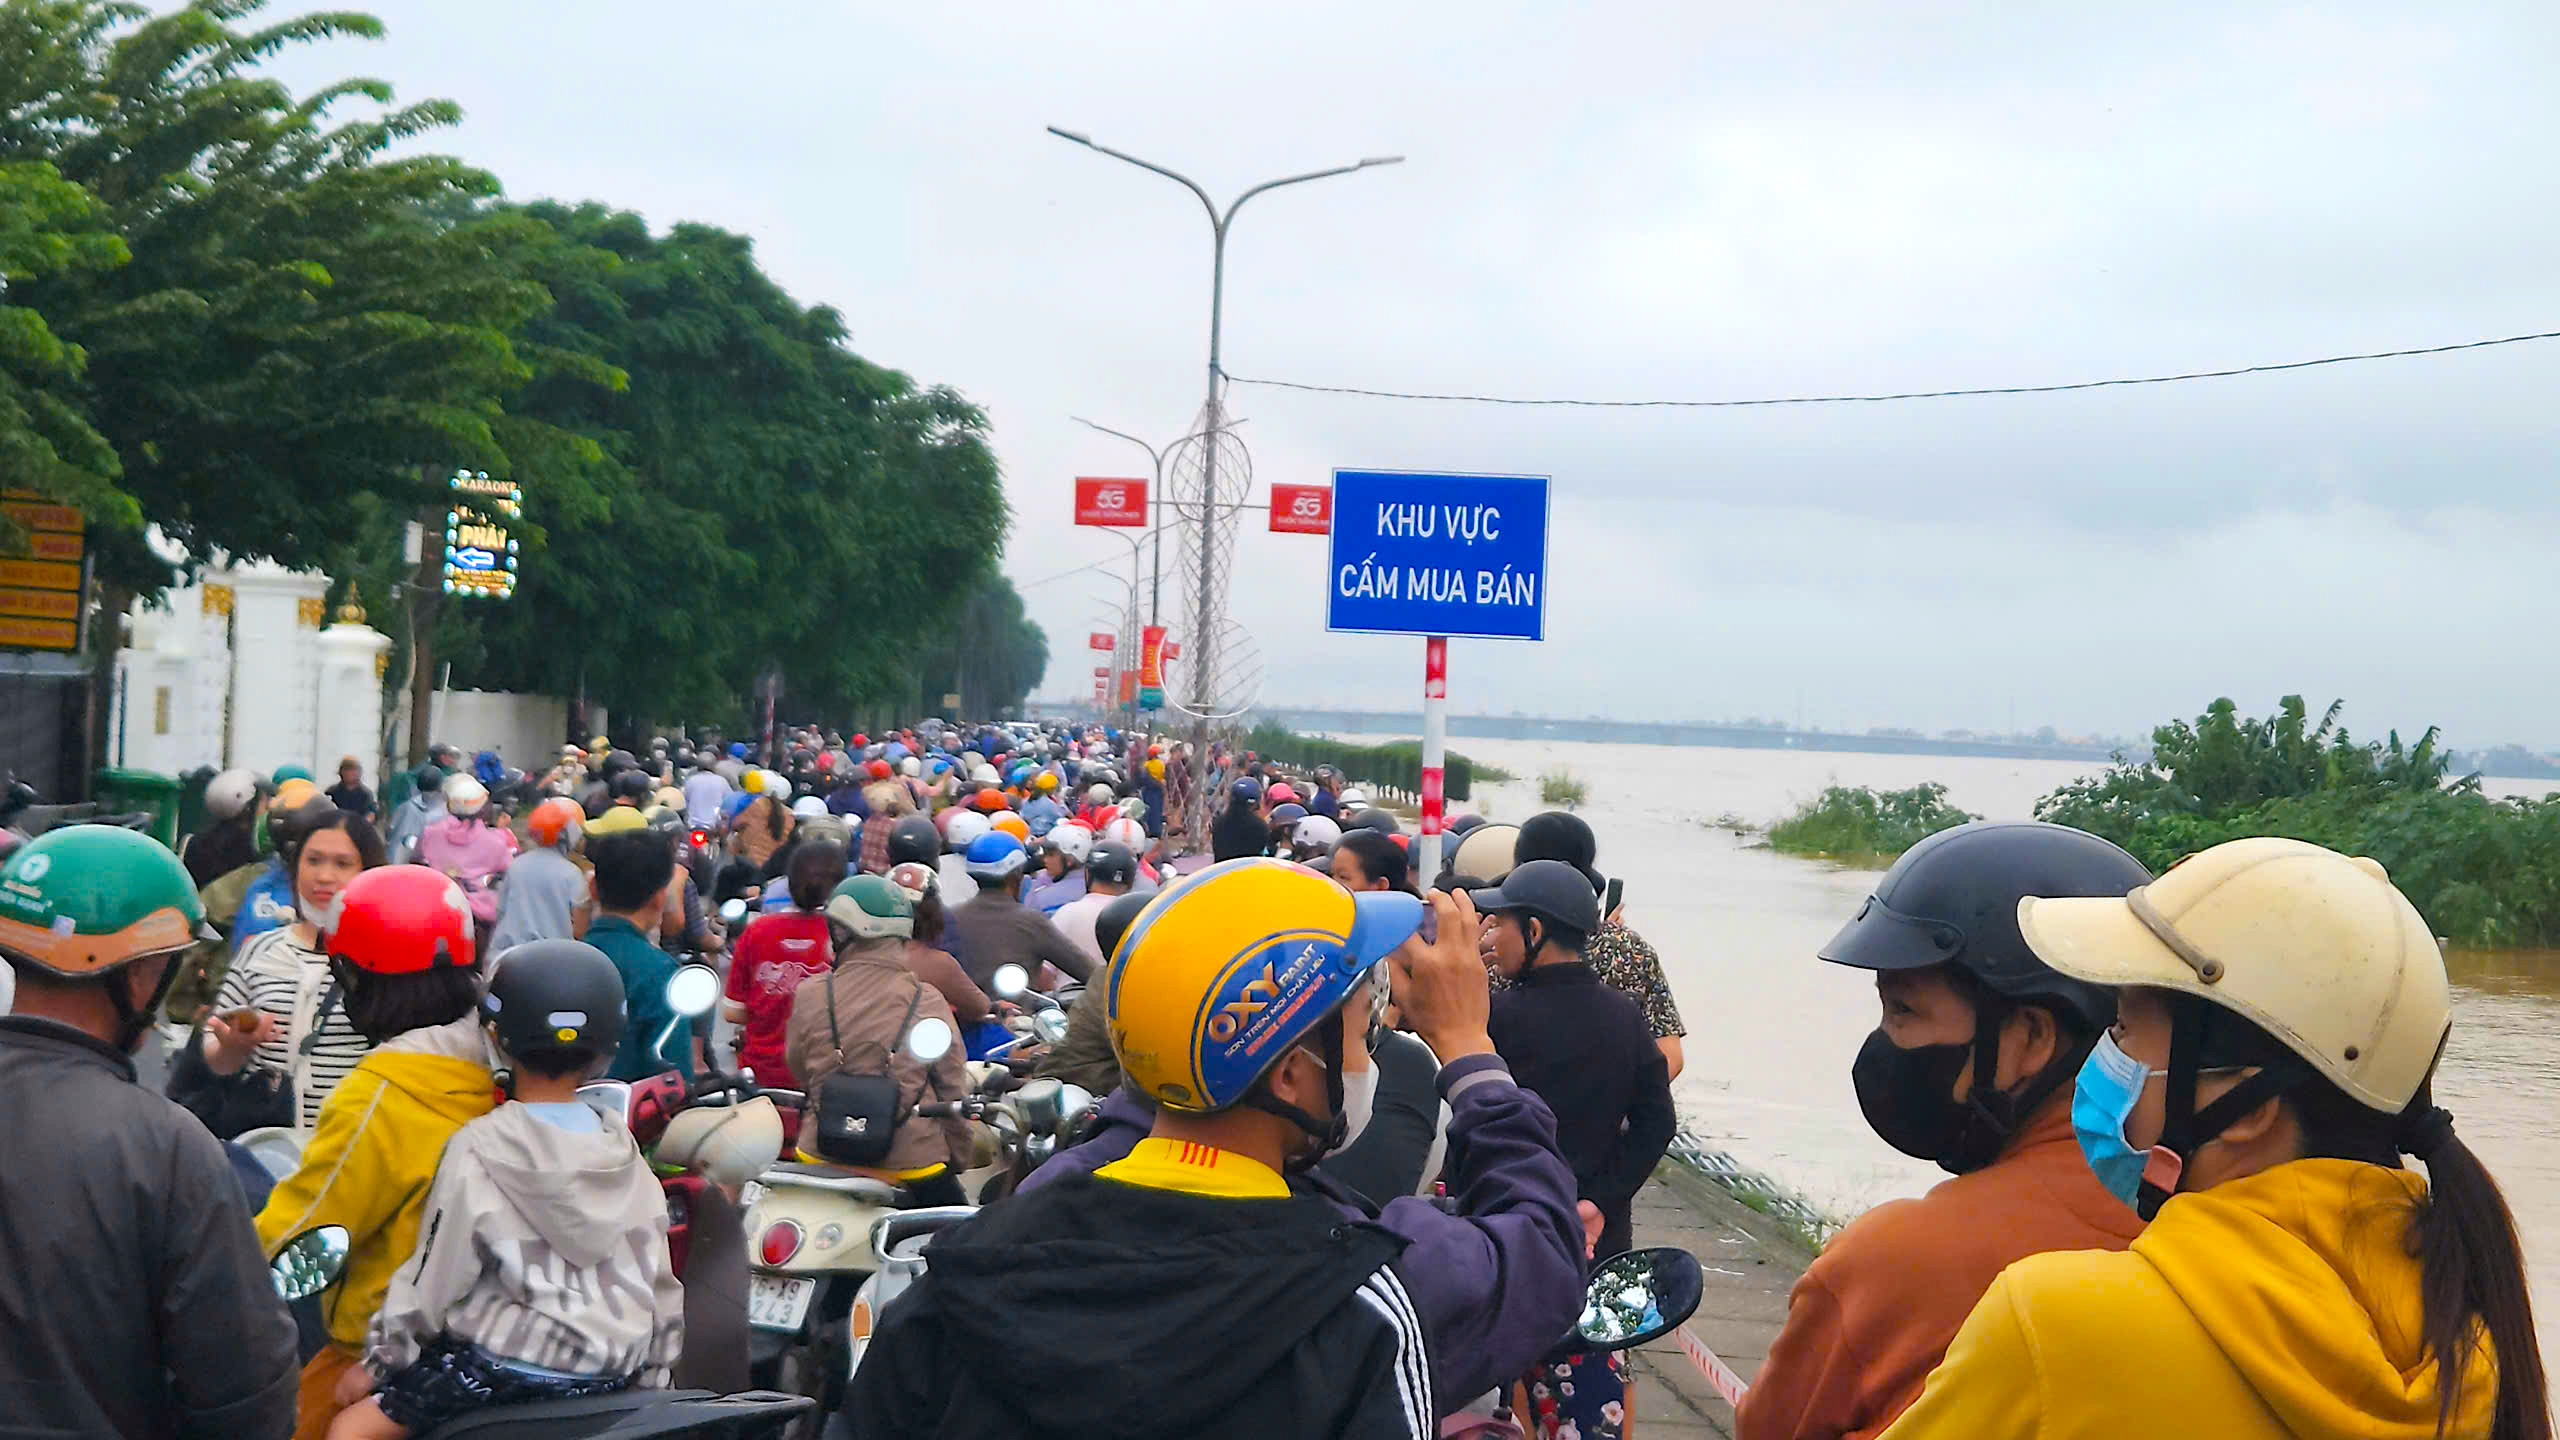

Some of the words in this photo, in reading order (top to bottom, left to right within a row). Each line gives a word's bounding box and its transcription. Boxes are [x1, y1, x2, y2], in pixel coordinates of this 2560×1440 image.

[460, 479, 518, 495] KARAOKE
[1095, 490, 1127, 509] 5G
[1292, 497, 1322, 516] 5G
[1377, 503, 1436, 538] KHU
[1444, 503, 1501, 546] VỰC
[1339, 552, 1398, 600] CẤM
[1407, 567, 1467, 603] MUA
[1476, 564, 1535, 607] BÁN
[1208, 960, 1280, 1042] OXY
[1279, 943, 1315, 986] PAINT
